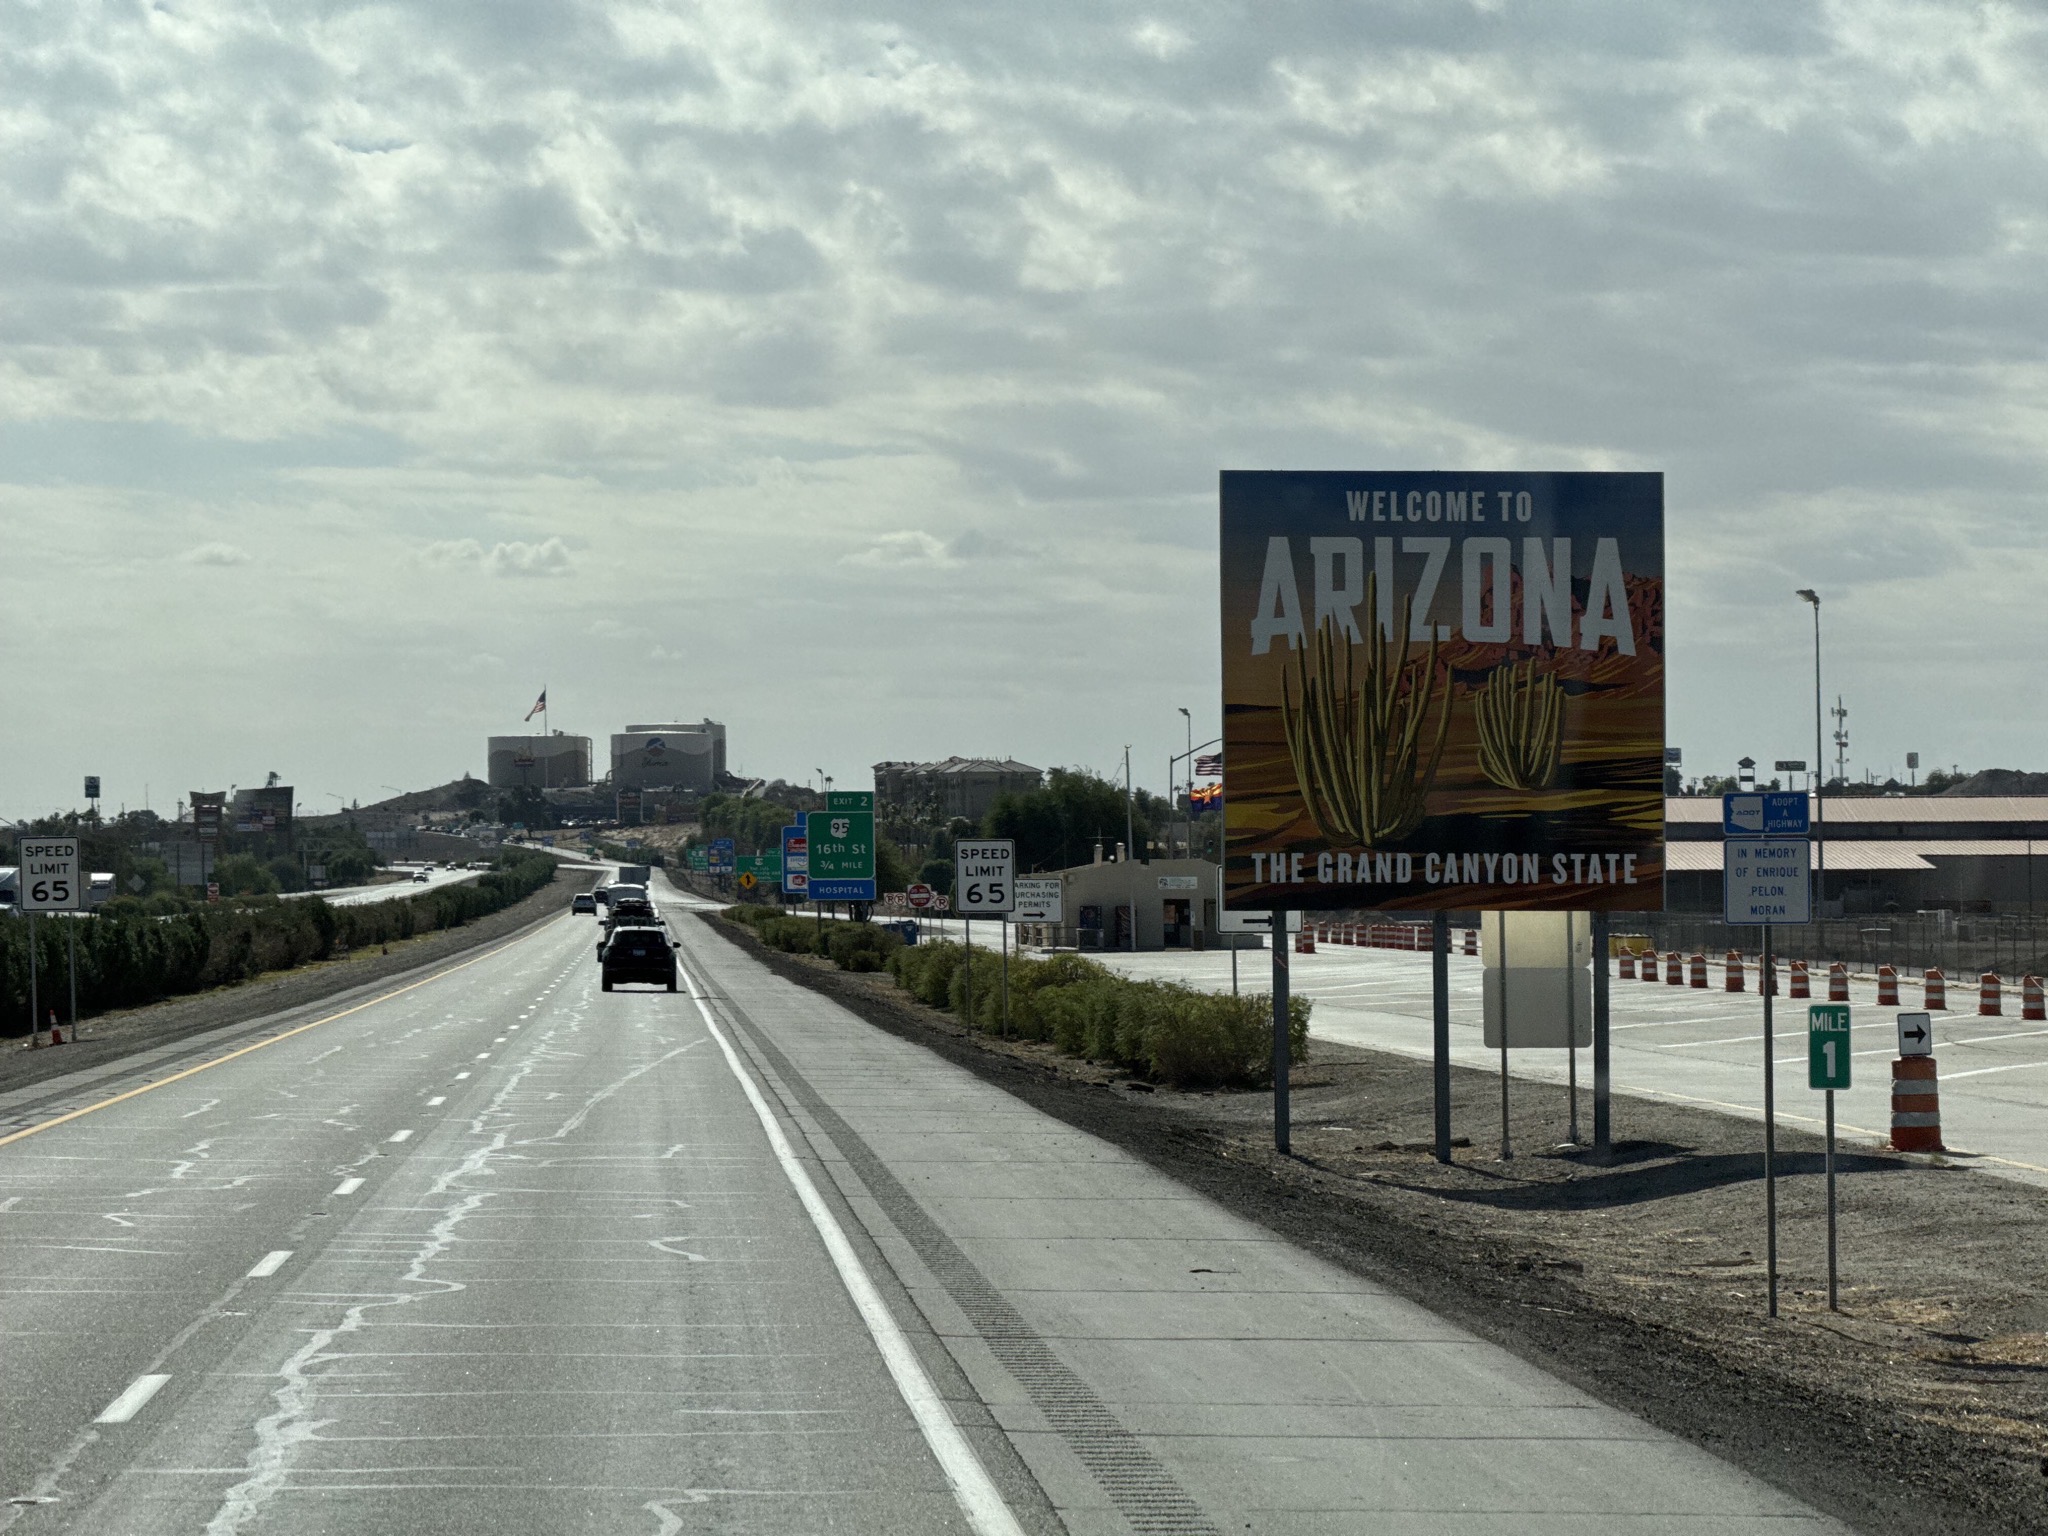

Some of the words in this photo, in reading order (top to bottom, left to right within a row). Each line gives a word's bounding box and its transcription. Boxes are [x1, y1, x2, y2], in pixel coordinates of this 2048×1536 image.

[1345, 490, 1486, 523] WELCOME
[1498, 491, 1533, 523] TO
[1250, 536, 1637, 657] ARIZONA
[833, 798, 853, 806] EXIT
[860, 796, 868, 807] 2
[1771, 797, 1799, 807] ADOPT
[1782, 809, 1789, 818] A
[832, 822, 850, 834] 95
[1767, 819, 1803, 829] HIGHWAY
[25, 846, 74, 857] SPEED
[815, 843, 845, 855] 16th
[851, 843, 867, 855] St
[960, 848, 1010, 860] SPEED
[1737, 848, 1747, 859] IN
[1754, 848, 1797, 859] MEMORY
[30, 863, 70, 875] LIMIT
[841, 861, 864, 870] MILE
[965, 865, 1005, 877] LIMIT
[1251, 852, 1305, 884] THE
[1316, 852, 1414, 884] GRAND
[1424, 853, 1541, 885] CANYON
[1551, 853, 1639, 885] STATE
[1735, 866, 1749, 878] OF
[1756, 866, 1800, 878] ENRIQUE
[32, 881, 69, 902] 65
[818, 886, 865, 895] HOSPITAL
[966, 882, 1006, 904] 65
[1015, 891, 1060, 899] URCHASING
[1018, 900, 1052, 908] PERMITS
[1750, 905, 1786, 916] MORAN
[1811, 1012, 1848, 1032] MILE
[1822, 1040, 1836, 1078] 1
